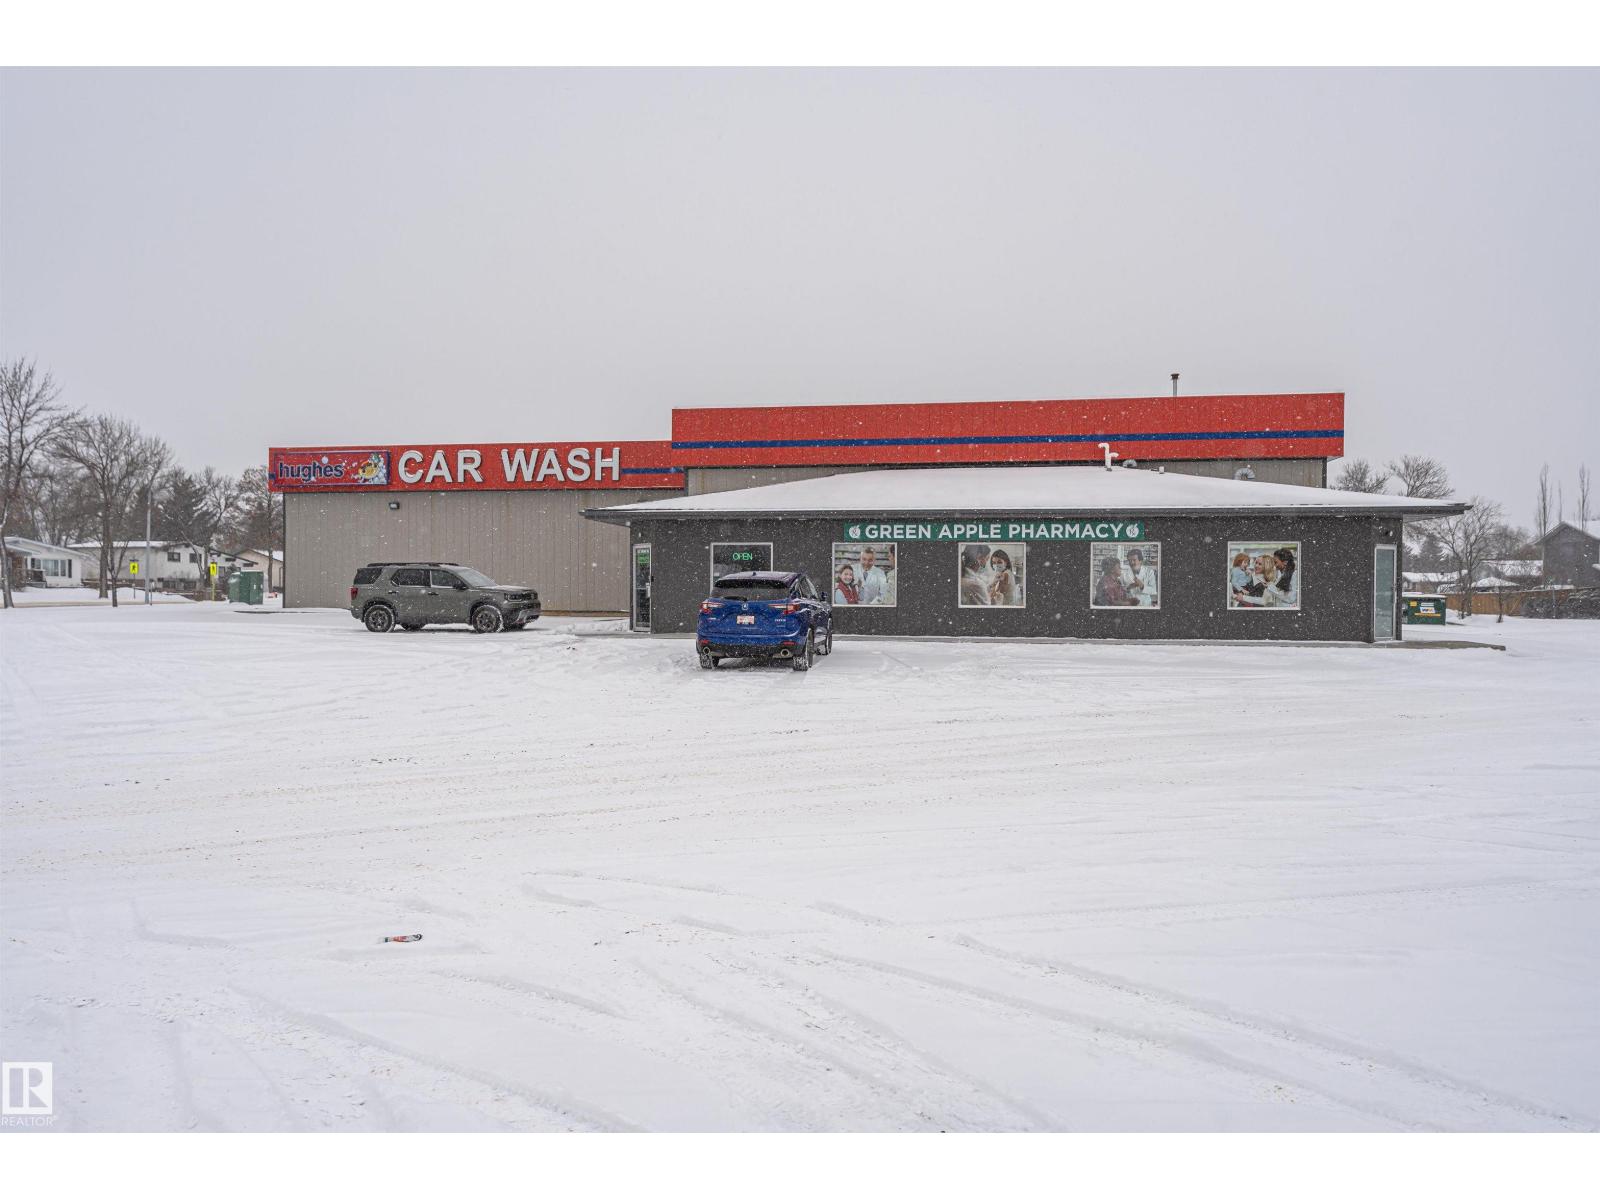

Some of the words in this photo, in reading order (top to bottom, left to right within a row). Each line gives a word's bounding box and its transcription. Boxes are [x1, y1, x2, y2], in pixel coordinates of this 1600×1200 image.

[278, 460, 345, 482] hughes
[398, 449, 484, 483] CAR
[501, 447, 620, 482] WASH
[865, 524, 931, 539] GREEN
[938, 524, 1002, 539] APPLE
[1008, 523, 1124, 539] PHARMACY
[732, 552, 753, 561] OPEN
